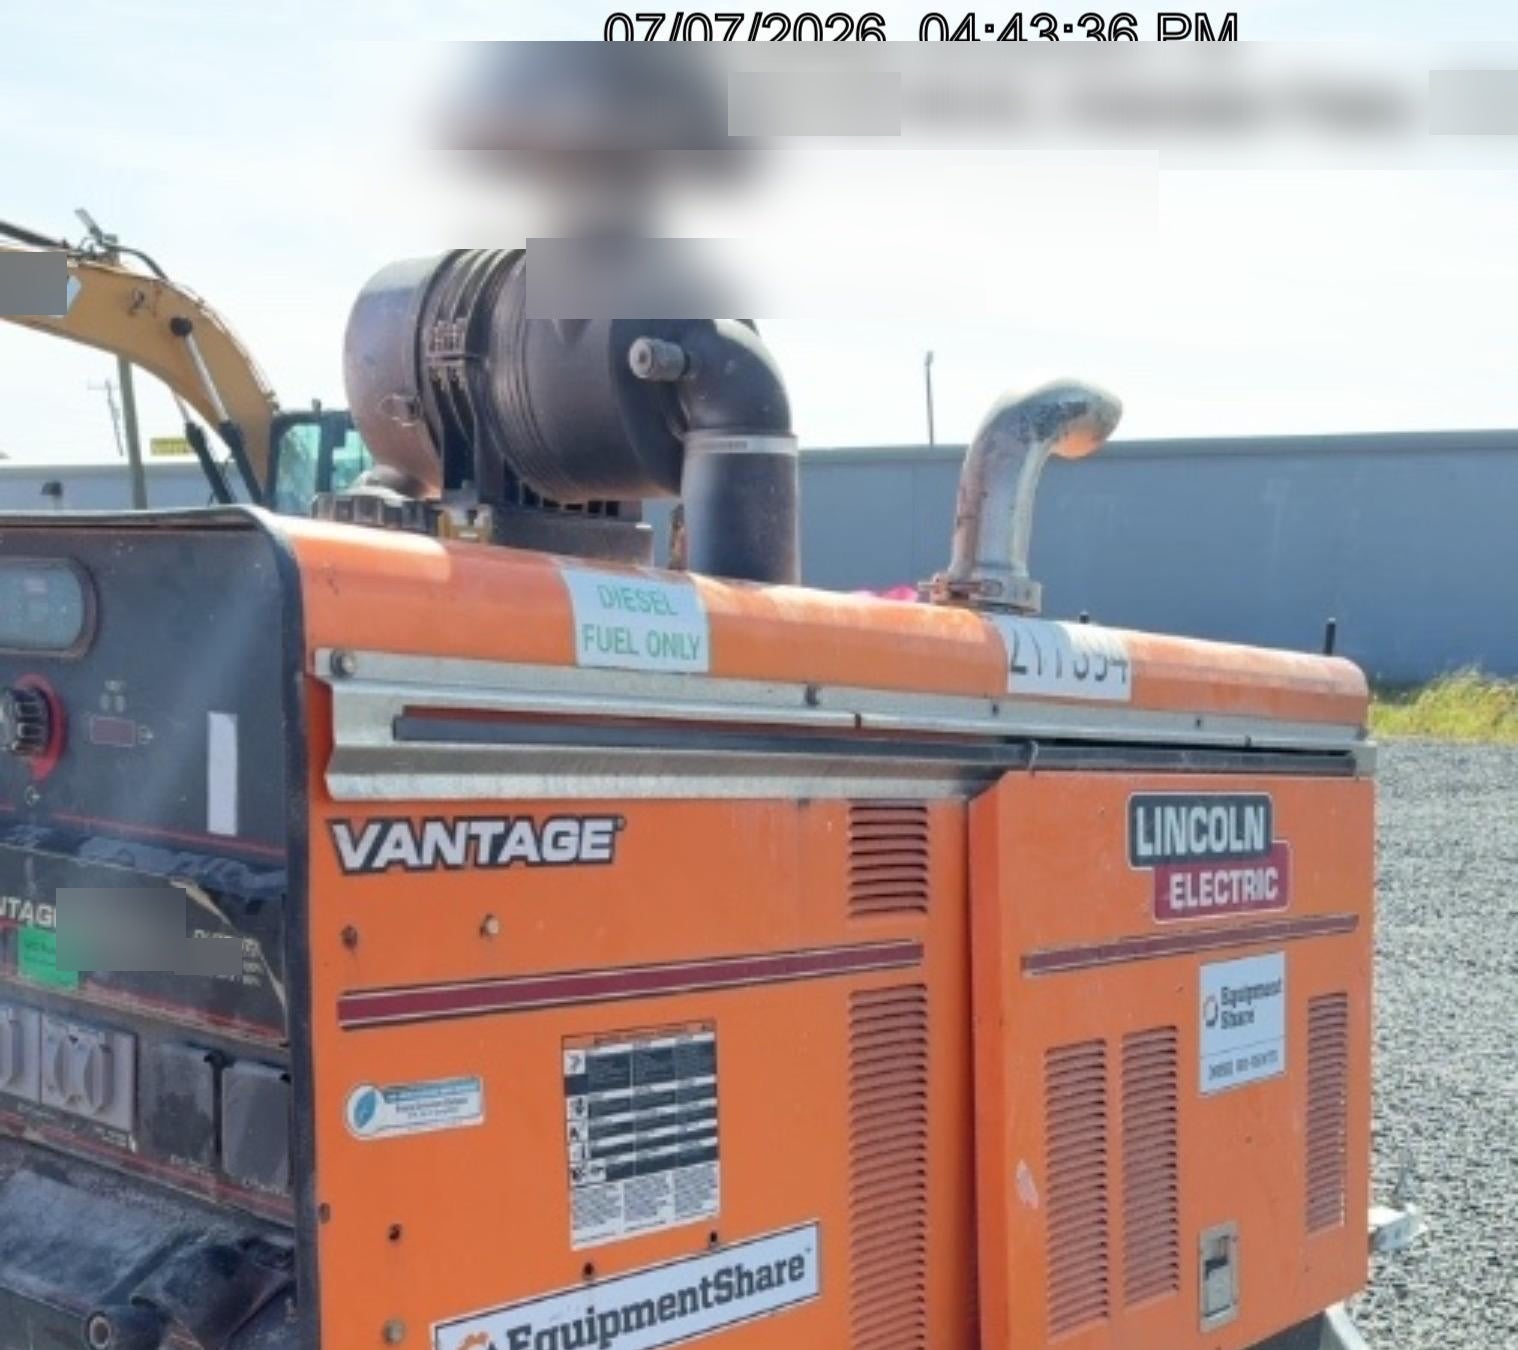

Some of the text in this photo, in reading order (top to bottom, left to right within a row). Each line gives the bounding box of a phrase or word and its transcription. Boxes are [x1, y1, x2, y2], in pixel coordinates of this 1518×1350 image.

[597, 584, 680, 616] DIESEL
[581, 623, 701, 661] FUEL ONLY
[327, 815, 618, 872] VANTAGE
[1135, 805, 1265, 857] LINCOLN
[1169, 867, 1280, 911] ELECTRIC
